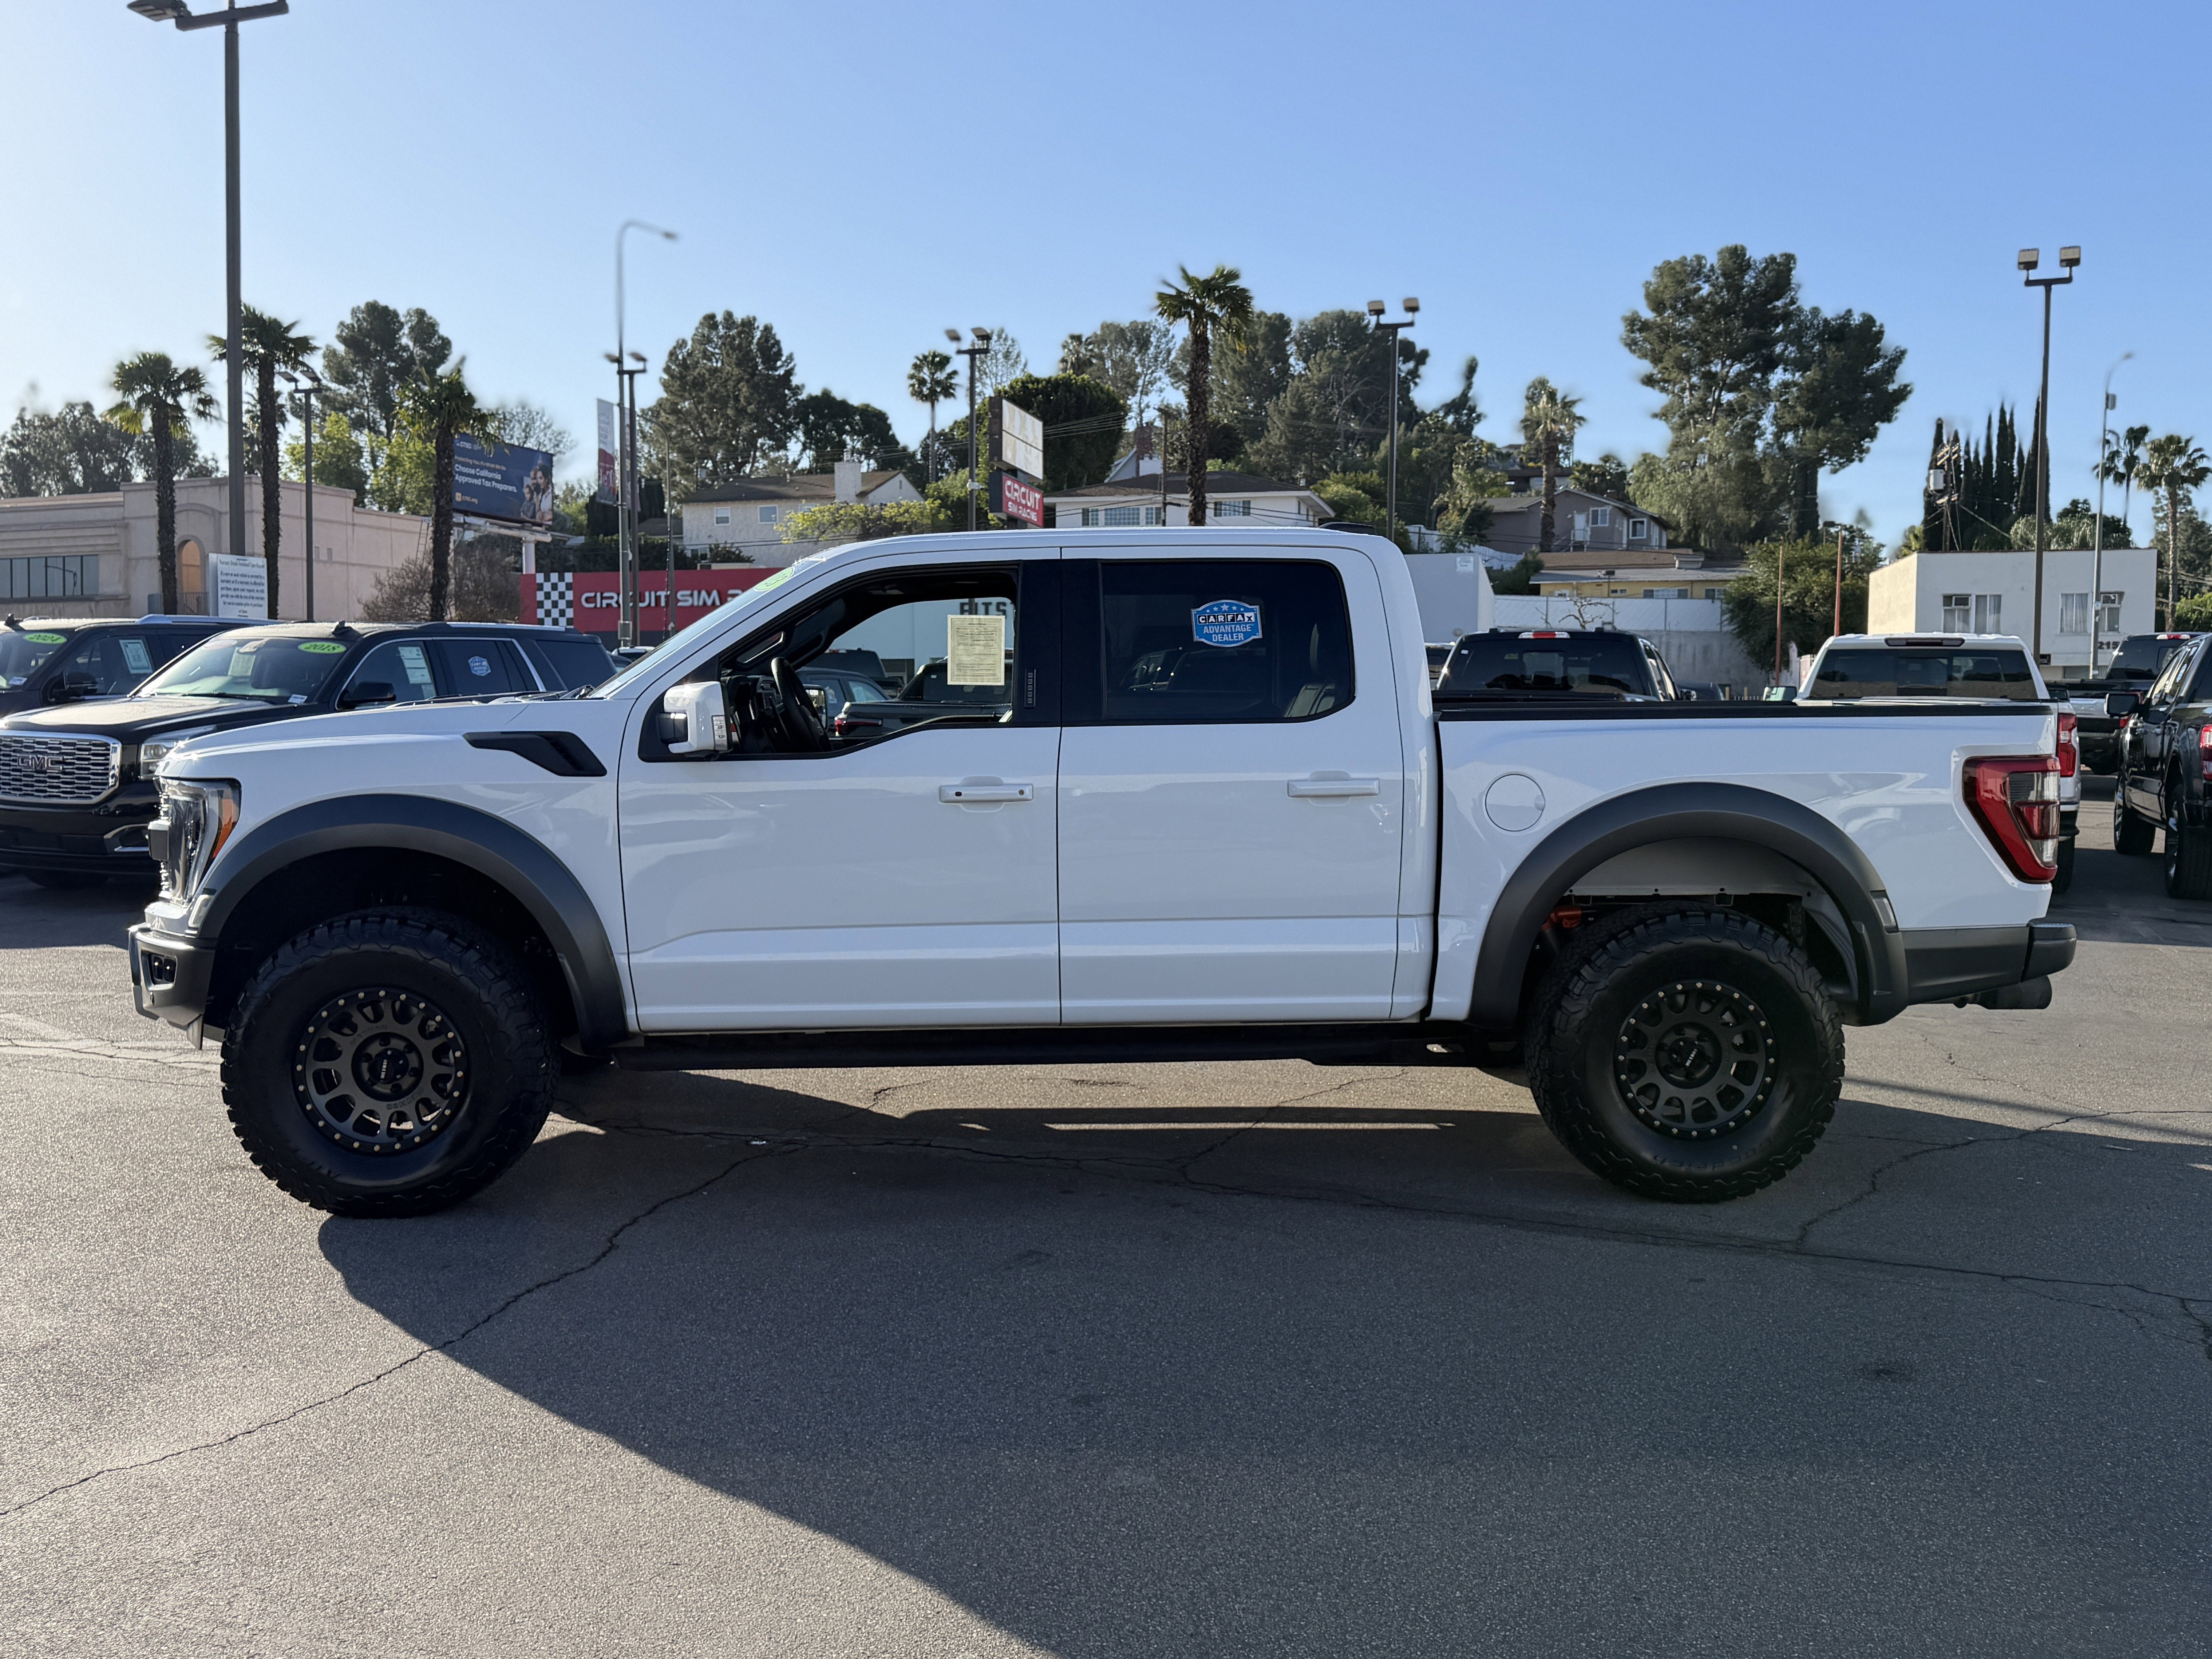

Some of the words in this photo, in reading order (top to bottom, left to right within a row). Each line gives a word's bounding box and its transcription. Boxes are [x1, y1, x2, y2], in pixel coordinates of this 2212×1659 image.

[1005, 480, 1041, 510] CIRCUIT
[677, 589, 720, 607] SIM
[1199, 613, 1253, 624] CARFAX
[1203, 624, 1252, 634] ADVANTAGE
[1212, 633, 1244, 642] DEALER
[18, 755, 62, 772] GMC
